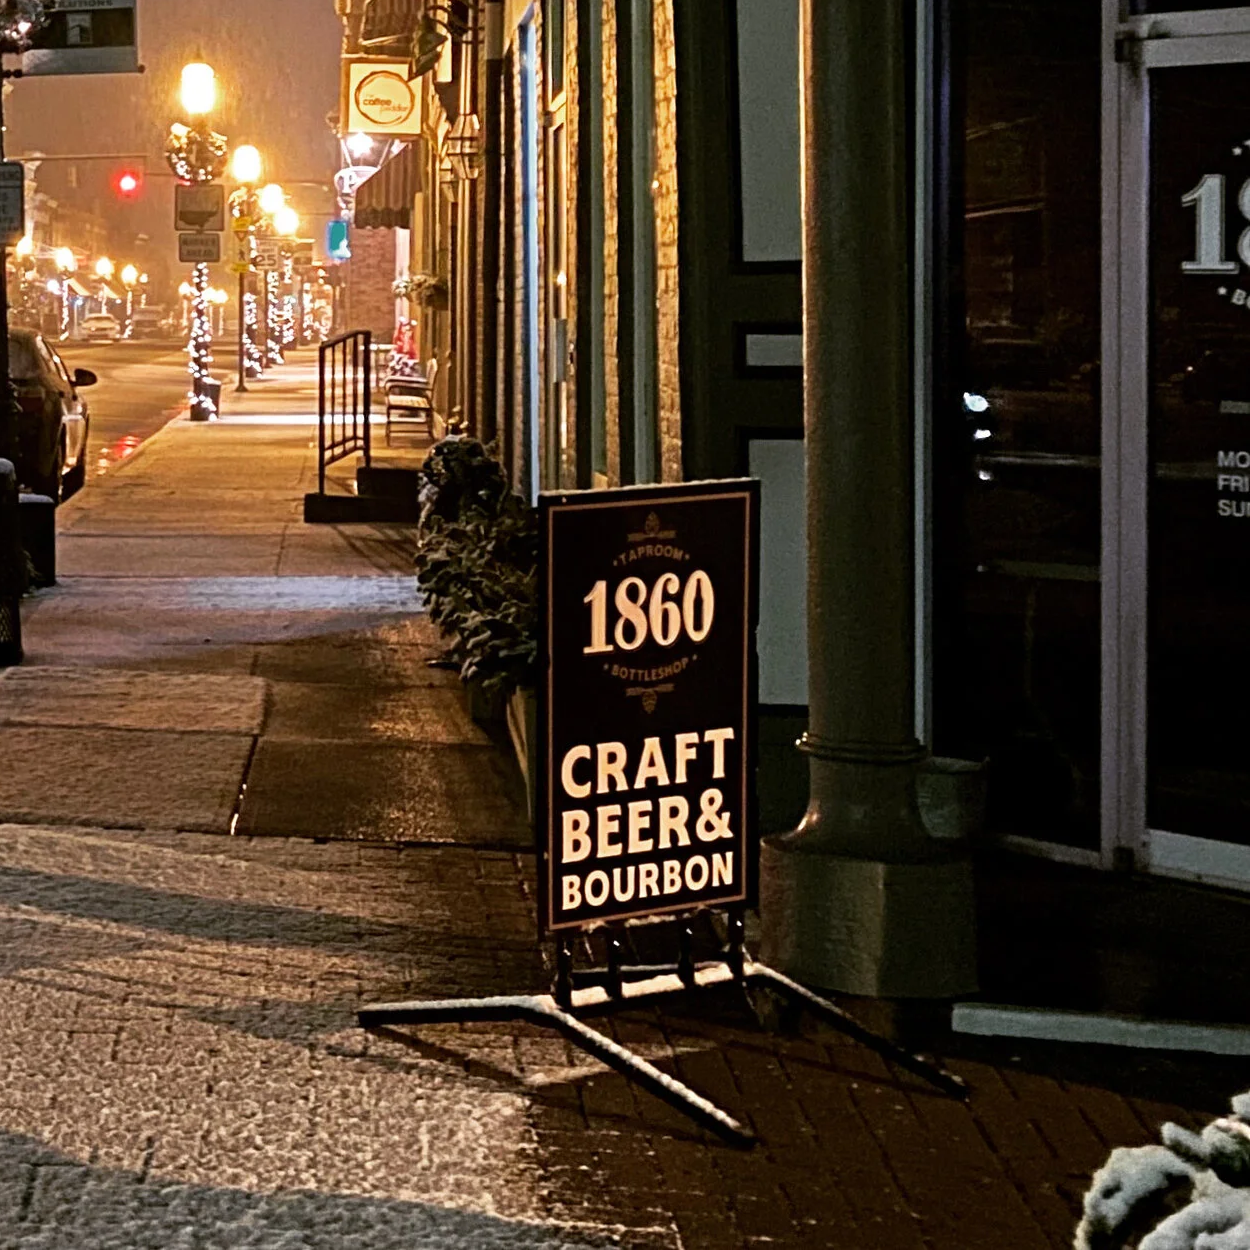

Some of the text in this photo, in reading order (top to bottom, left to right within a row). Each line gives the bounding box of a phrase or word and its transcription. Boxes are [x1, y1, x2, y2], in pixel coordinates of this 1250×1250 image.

[1181, 173, 1250, 275] 1
[254, 255, 277, 267] 25
[1218, 474, 1250, 492] FRI
[1218, 499, 1250, 517] SU
[619, 545, 684, 566] TAPROOM
[583, 569, 715, 654] 1860
[611, 657, 690, 682] BOTTLESHOP
[560, 726, 735, 800] CRAFT
[561, 851, 734, 911] BOURBON
